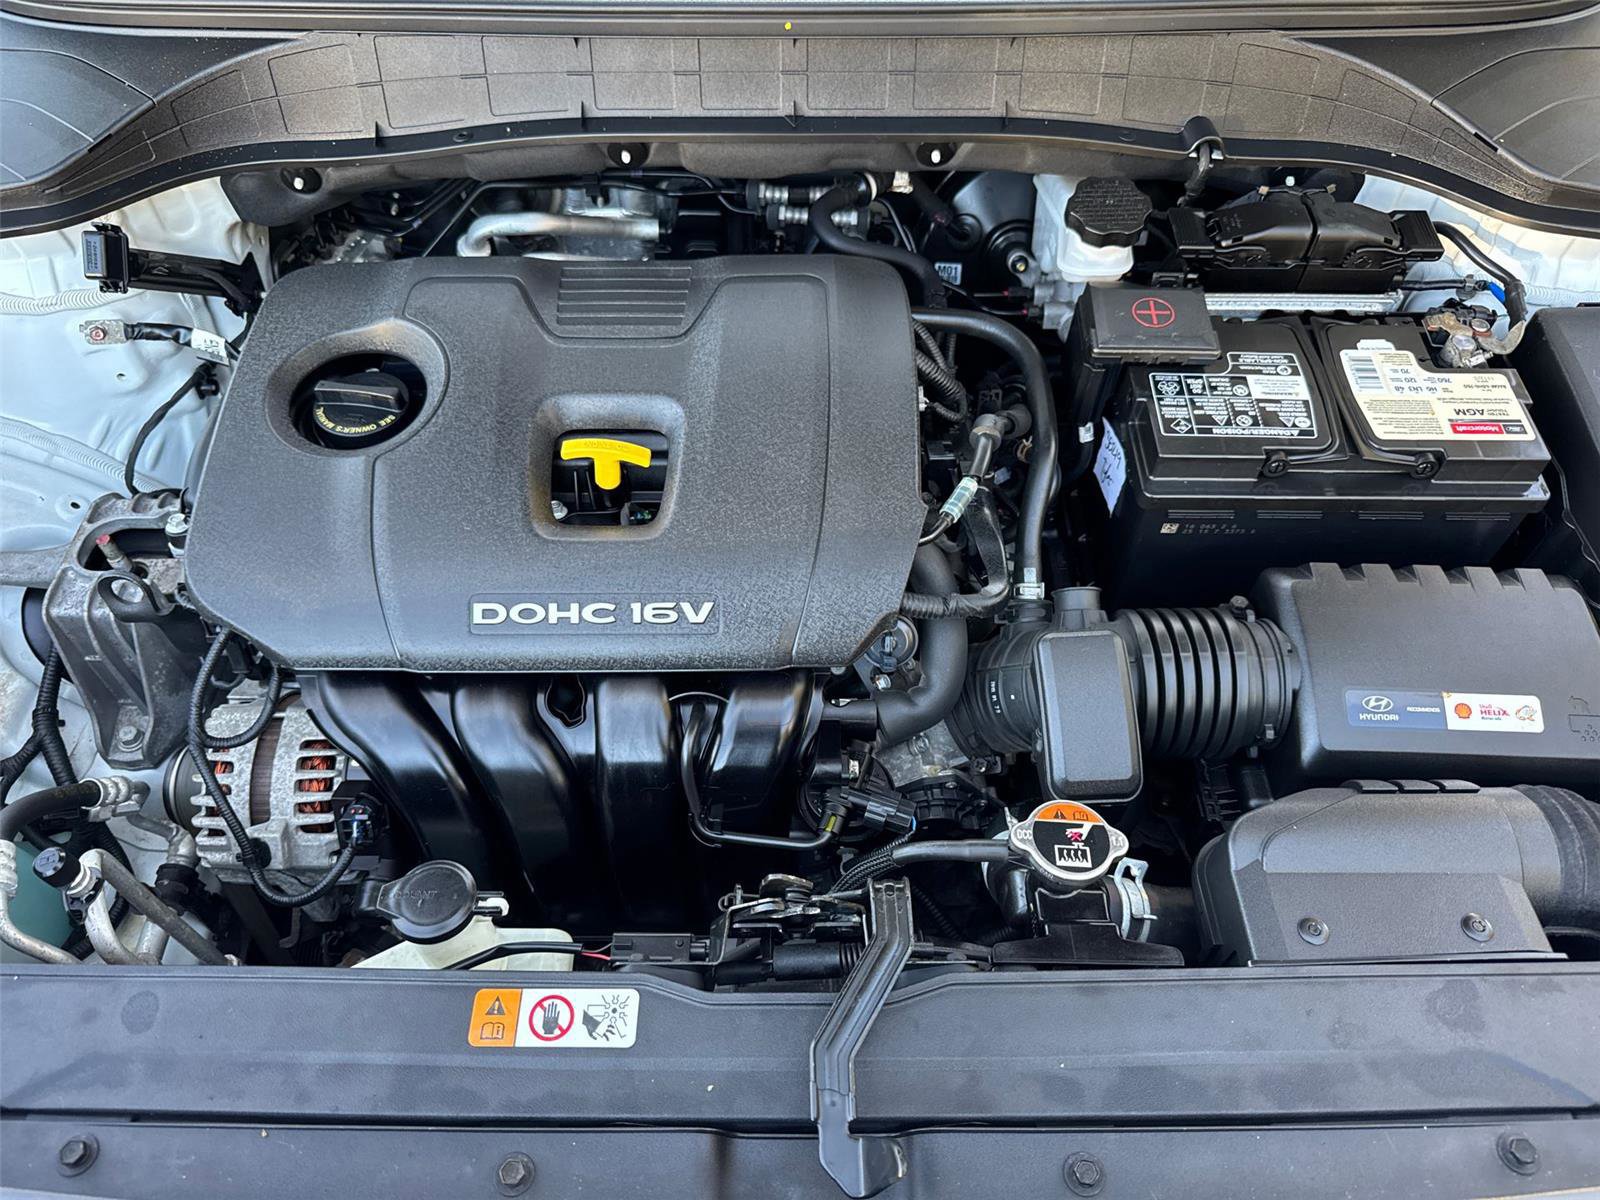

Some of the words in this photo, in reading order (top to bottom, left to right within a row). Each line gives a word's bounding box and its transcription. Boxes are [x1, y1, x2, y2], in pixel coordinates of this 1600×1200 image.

[378, 414, 396, 426] SEE
[336, 424, 377, 434] OWNER'S
[472, 602, 616, 624] DOHC
[630, 602, 714, 624] 16V
[1359, 713, 1399, 721] HYUNDAI
[1017, 830, 1032, 839] DCC
